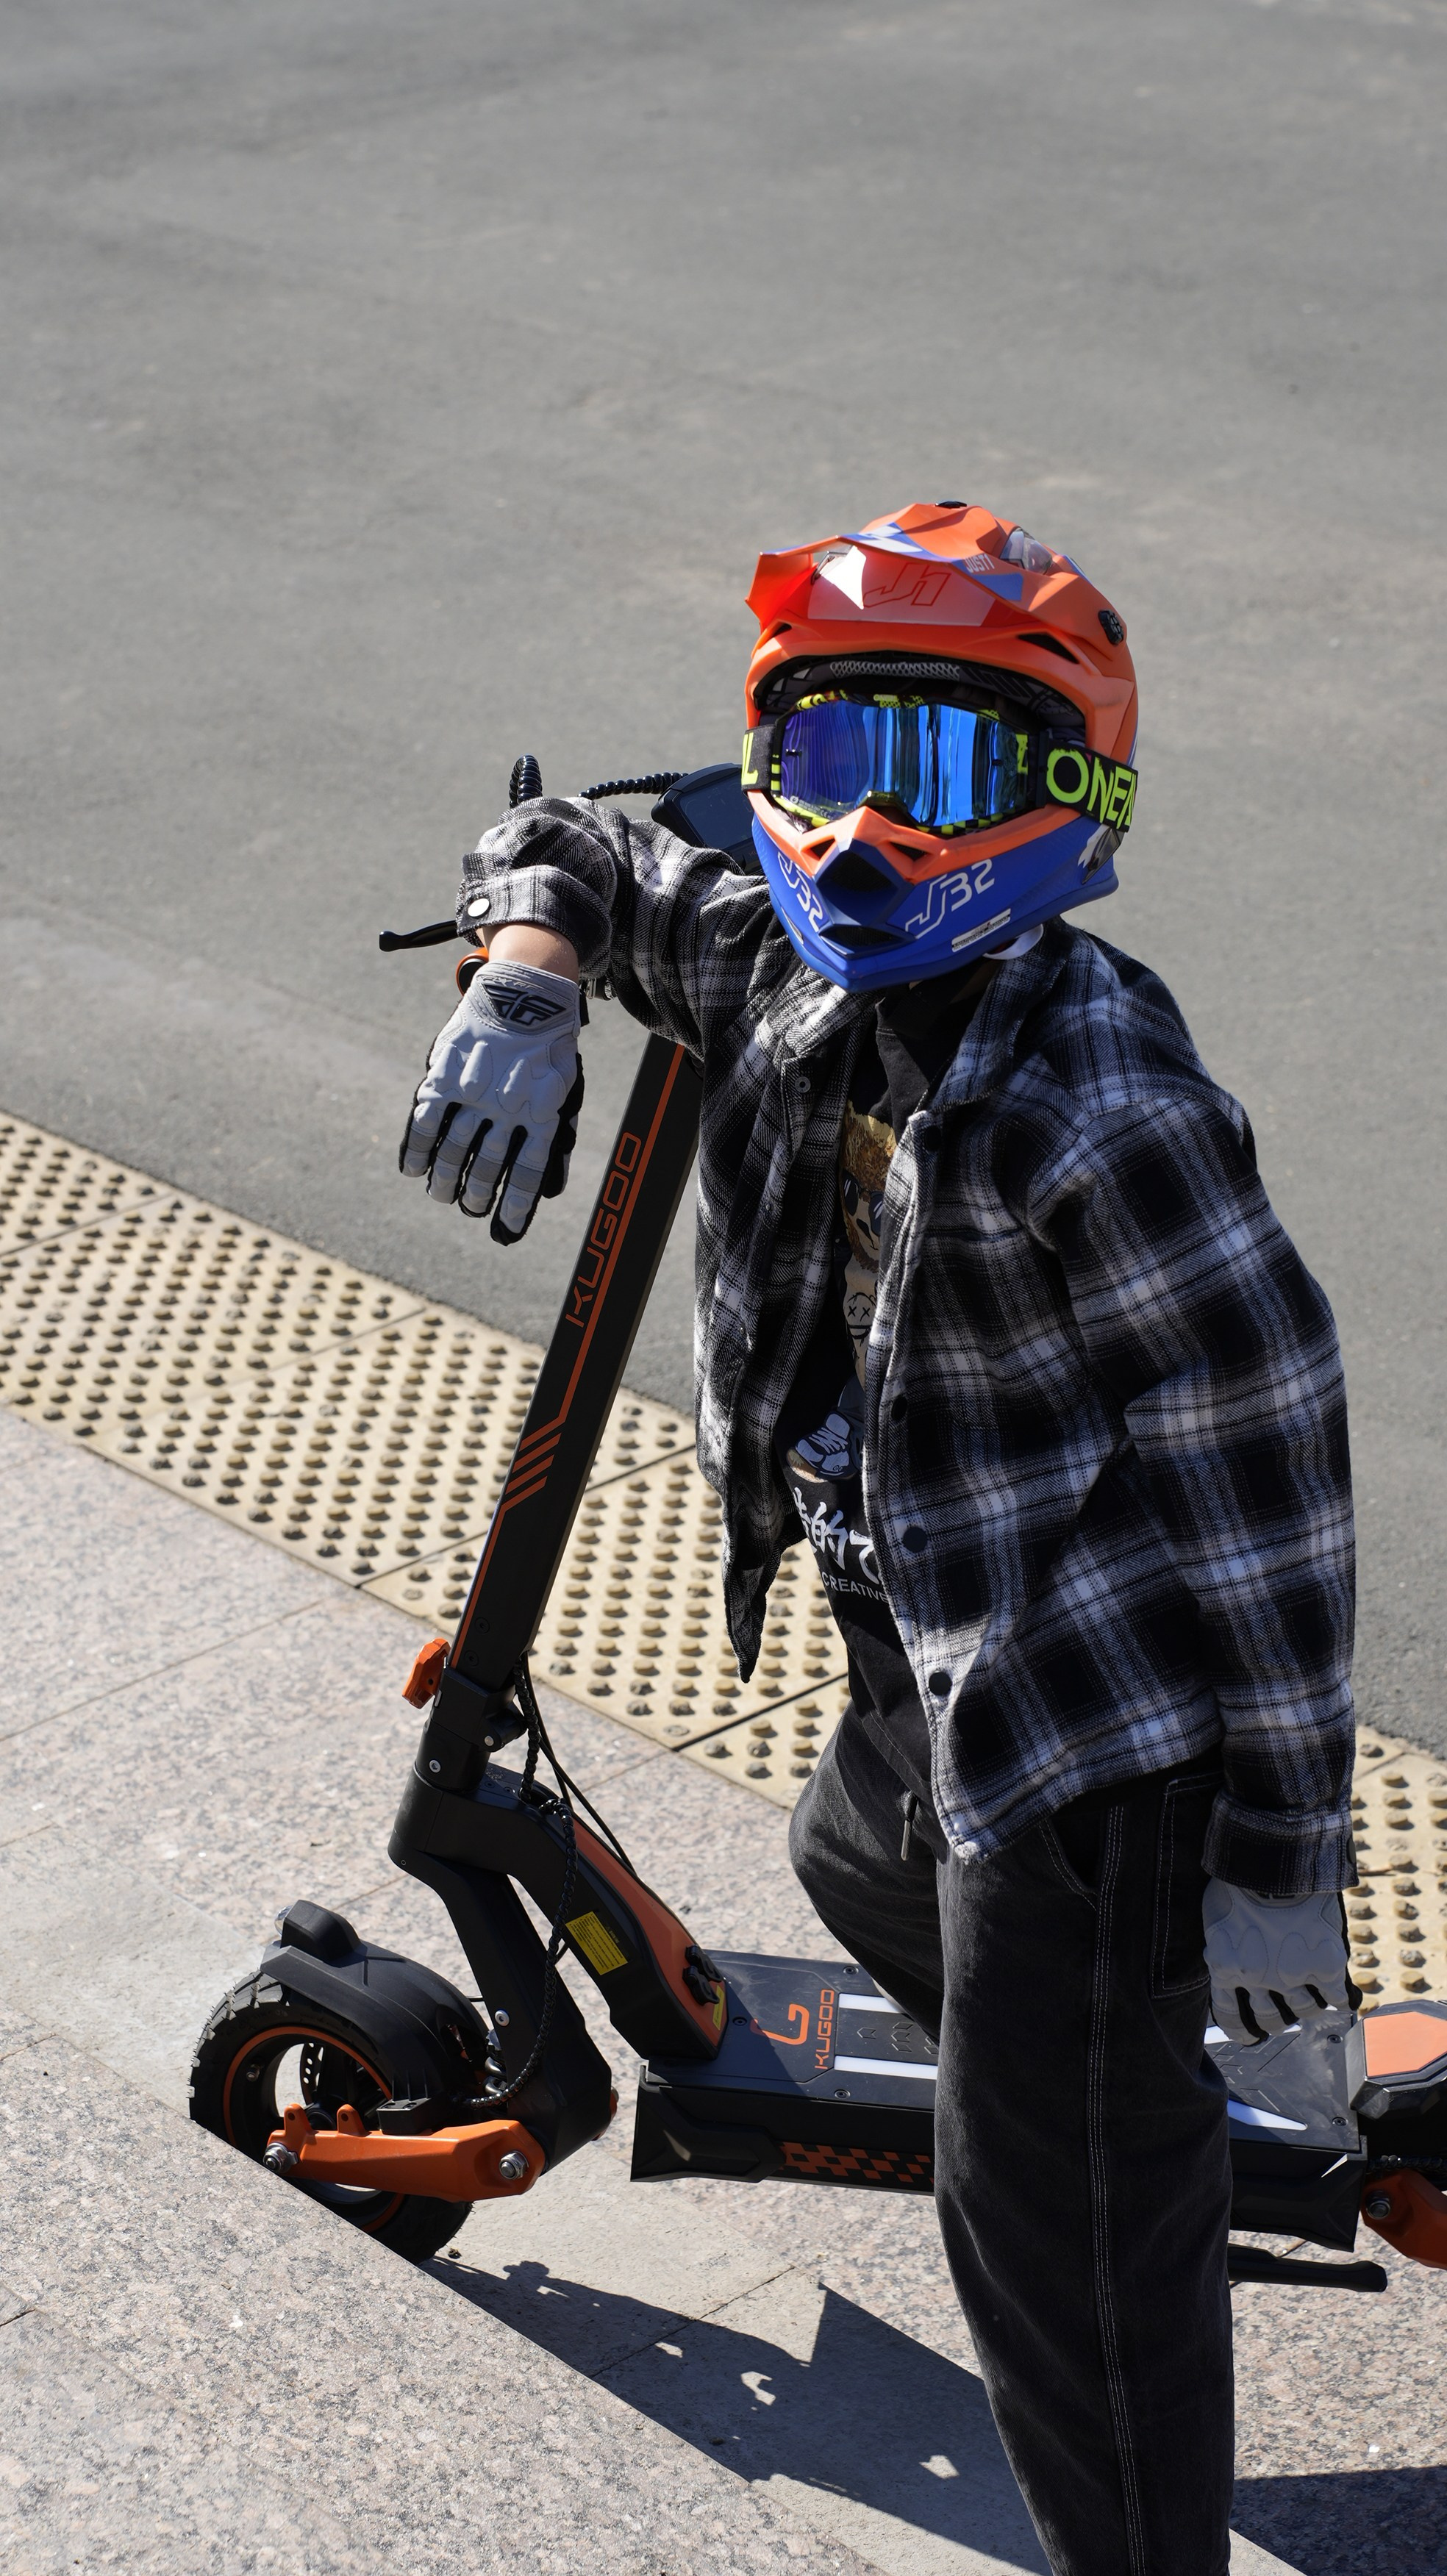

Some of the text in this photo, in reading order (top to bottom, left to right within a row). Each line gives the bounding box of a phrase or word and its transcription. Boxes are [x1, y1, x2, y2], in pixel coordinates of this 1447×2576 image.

[965, 553, 995, 573] JUST1
[565, 1132, 642, 1328] KUGOO
[814, 1989, 835, 2069] KUGOO
